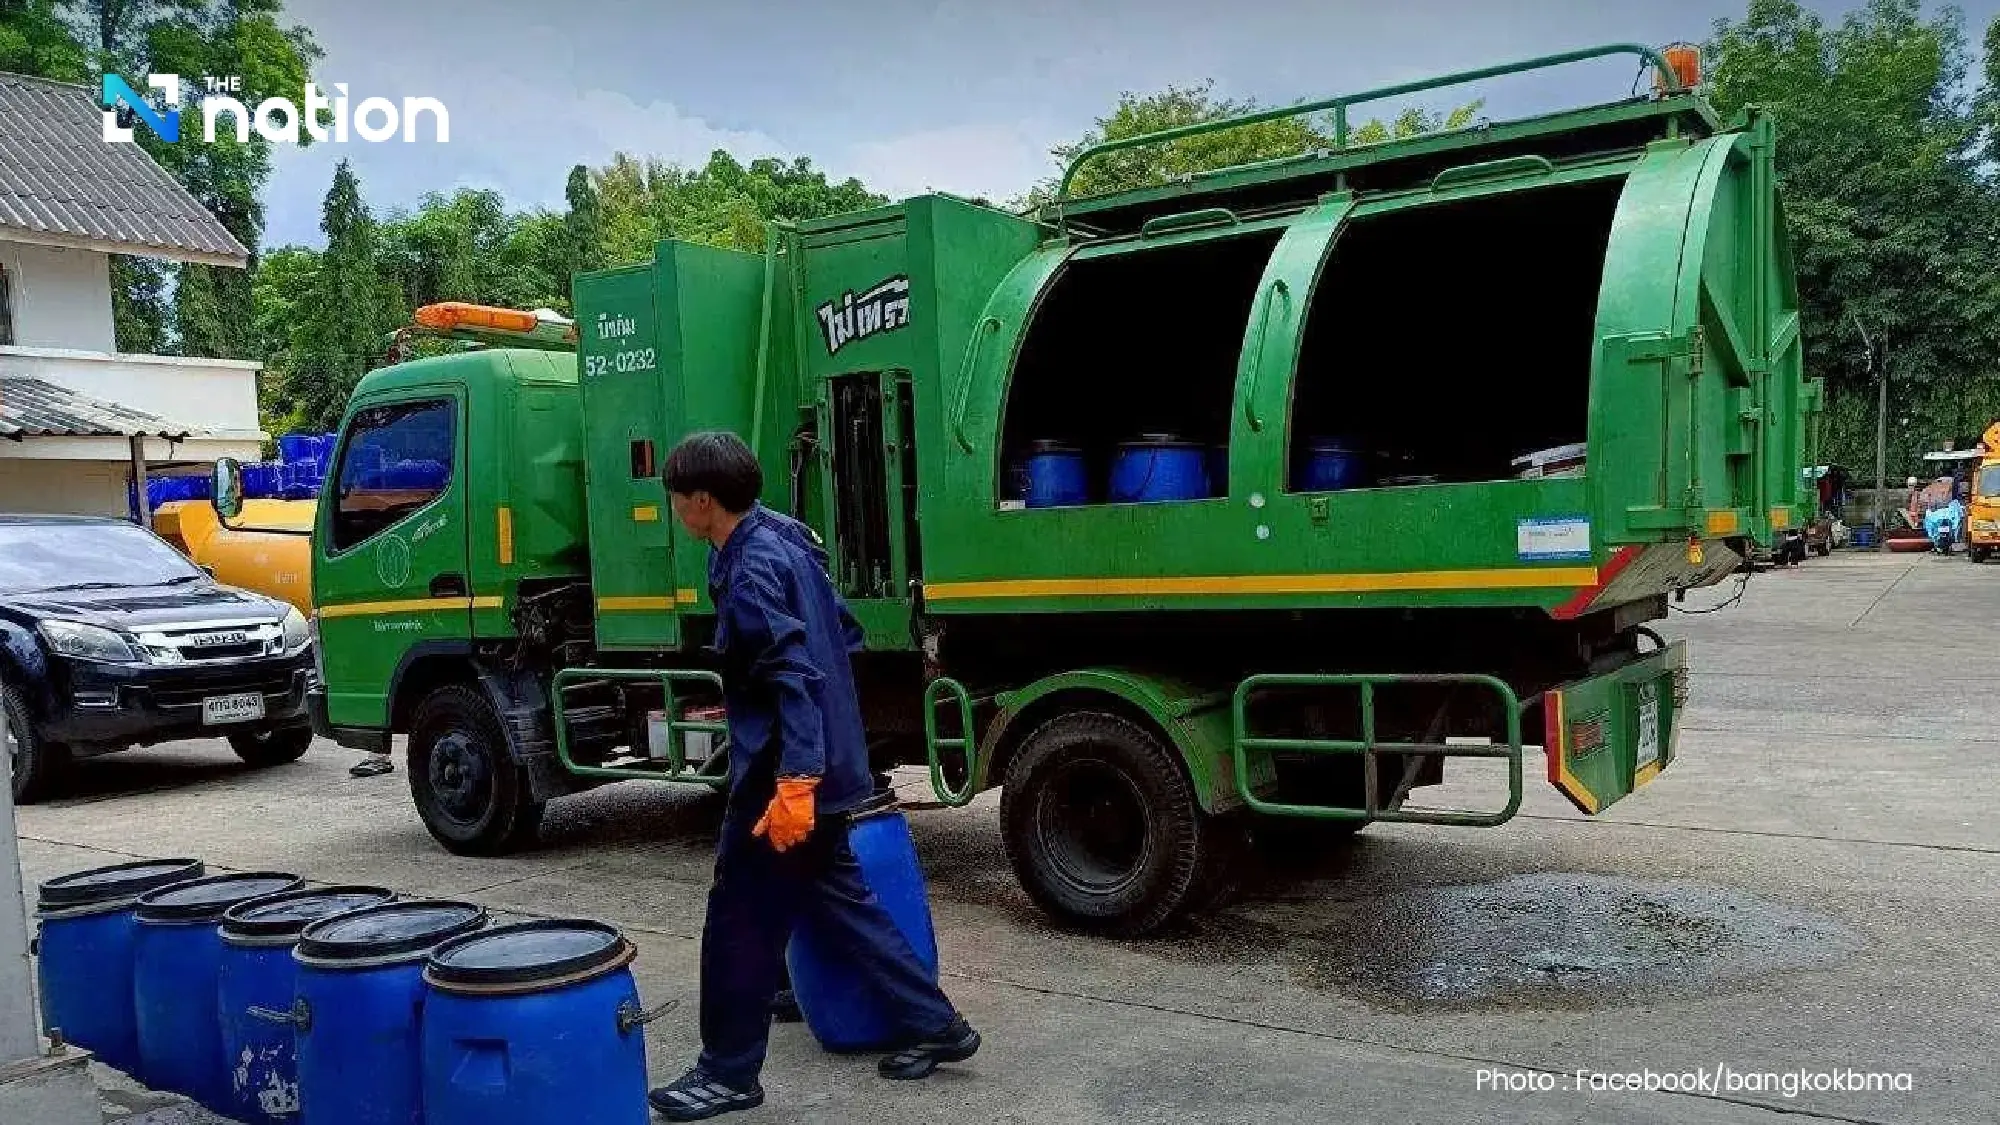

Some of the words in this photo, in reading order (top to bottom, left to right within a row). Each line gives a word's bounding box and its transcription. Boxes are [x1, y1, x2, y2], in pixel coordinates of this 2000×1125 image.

[816, 277, 909, 353] ไม่เทรว
[585, 347, 656, 377] 52-0232
